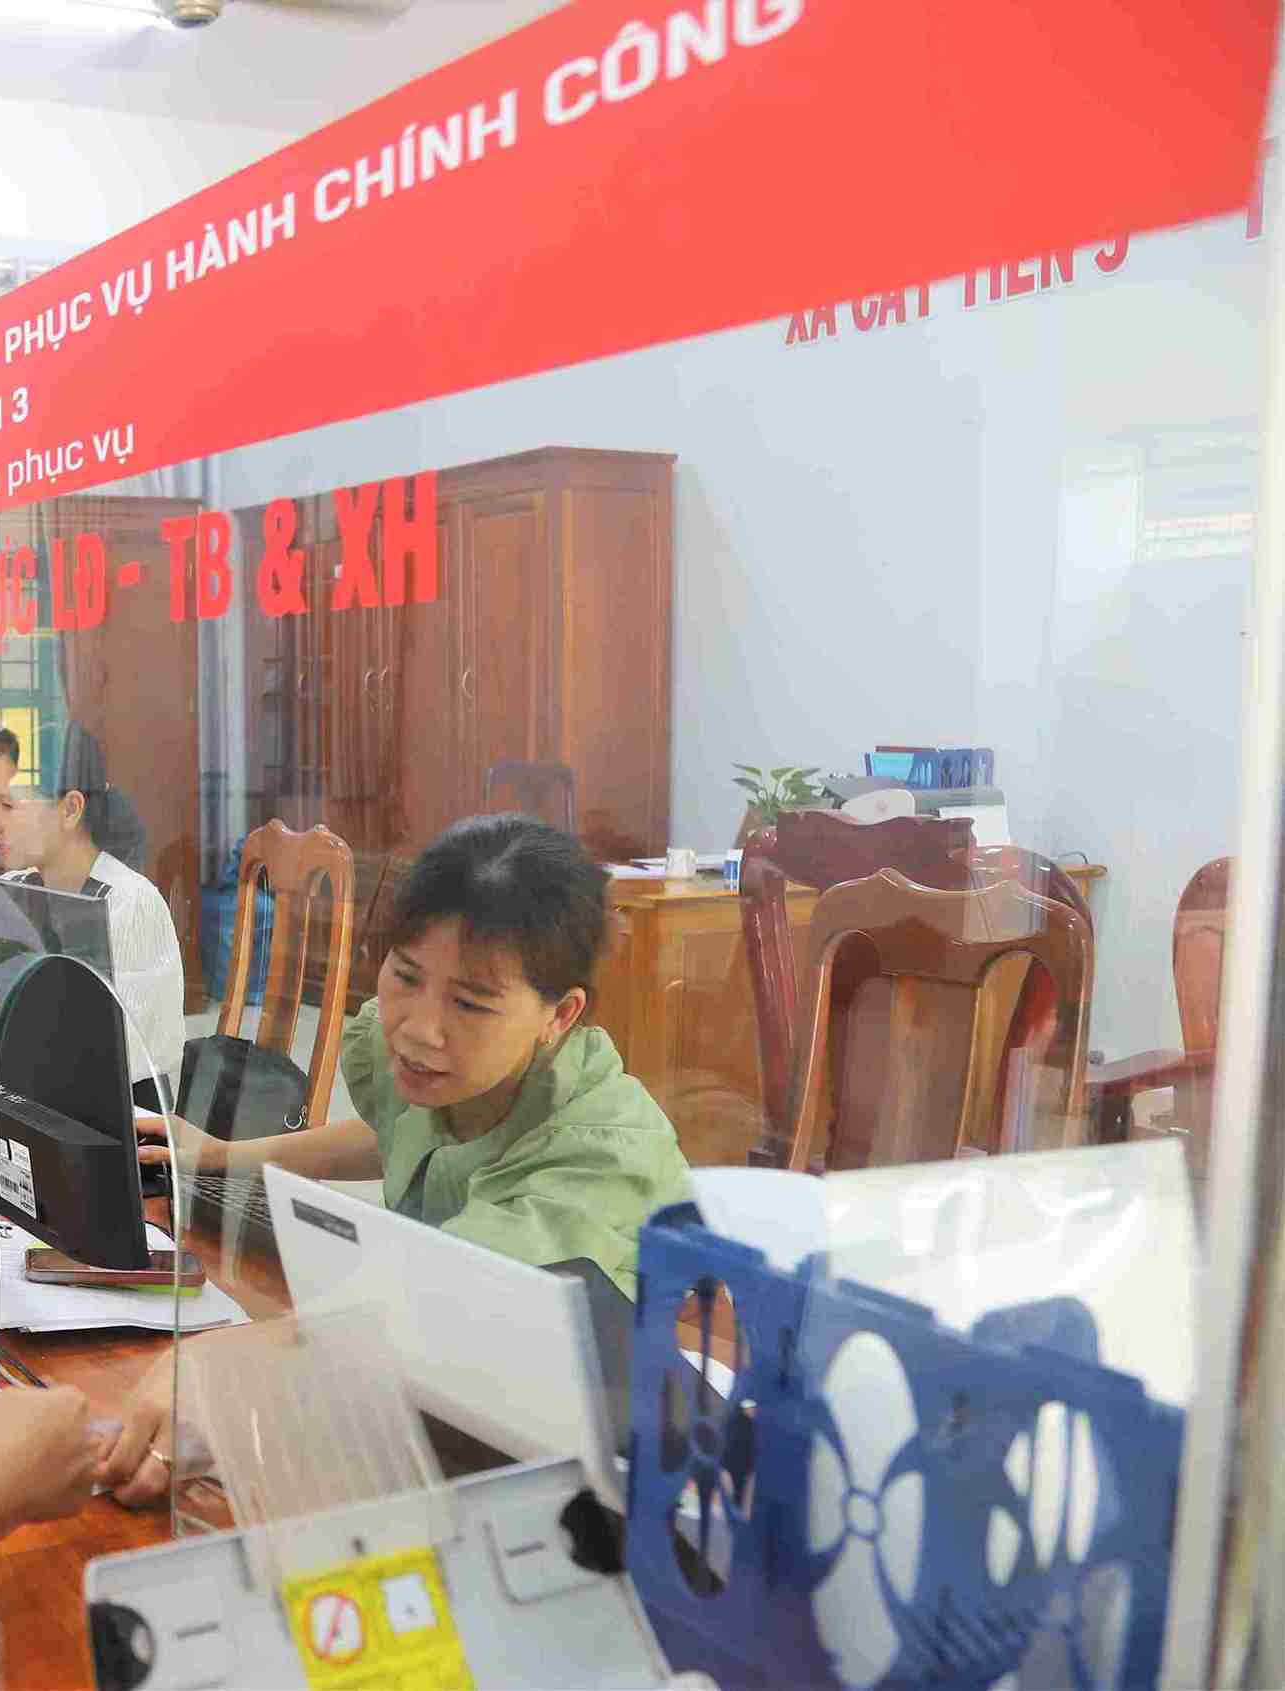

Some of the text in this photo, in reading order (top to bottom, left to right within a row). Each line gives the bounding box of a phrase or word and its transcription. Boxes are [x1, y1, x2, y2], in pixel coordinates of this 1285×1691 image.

[4, 292, 91, 364] PHỤC
[101, 261, 152, 315] VỤ
[167, 191, 296, 291] HÀNH
[313, 88, 517, 223] CHÍNH
[543, 0, 805, 126] CÔNG
[8, 441, 84, 496] phục
[93, 424, 134, 464] vụ
[11, 387, 29, 423] 3
[51, 532, 106, 632] LĐ
[160, 511, 232, 624] TB
[257, 497, 310, 618] &
[330, 470, 439, 611] XH
